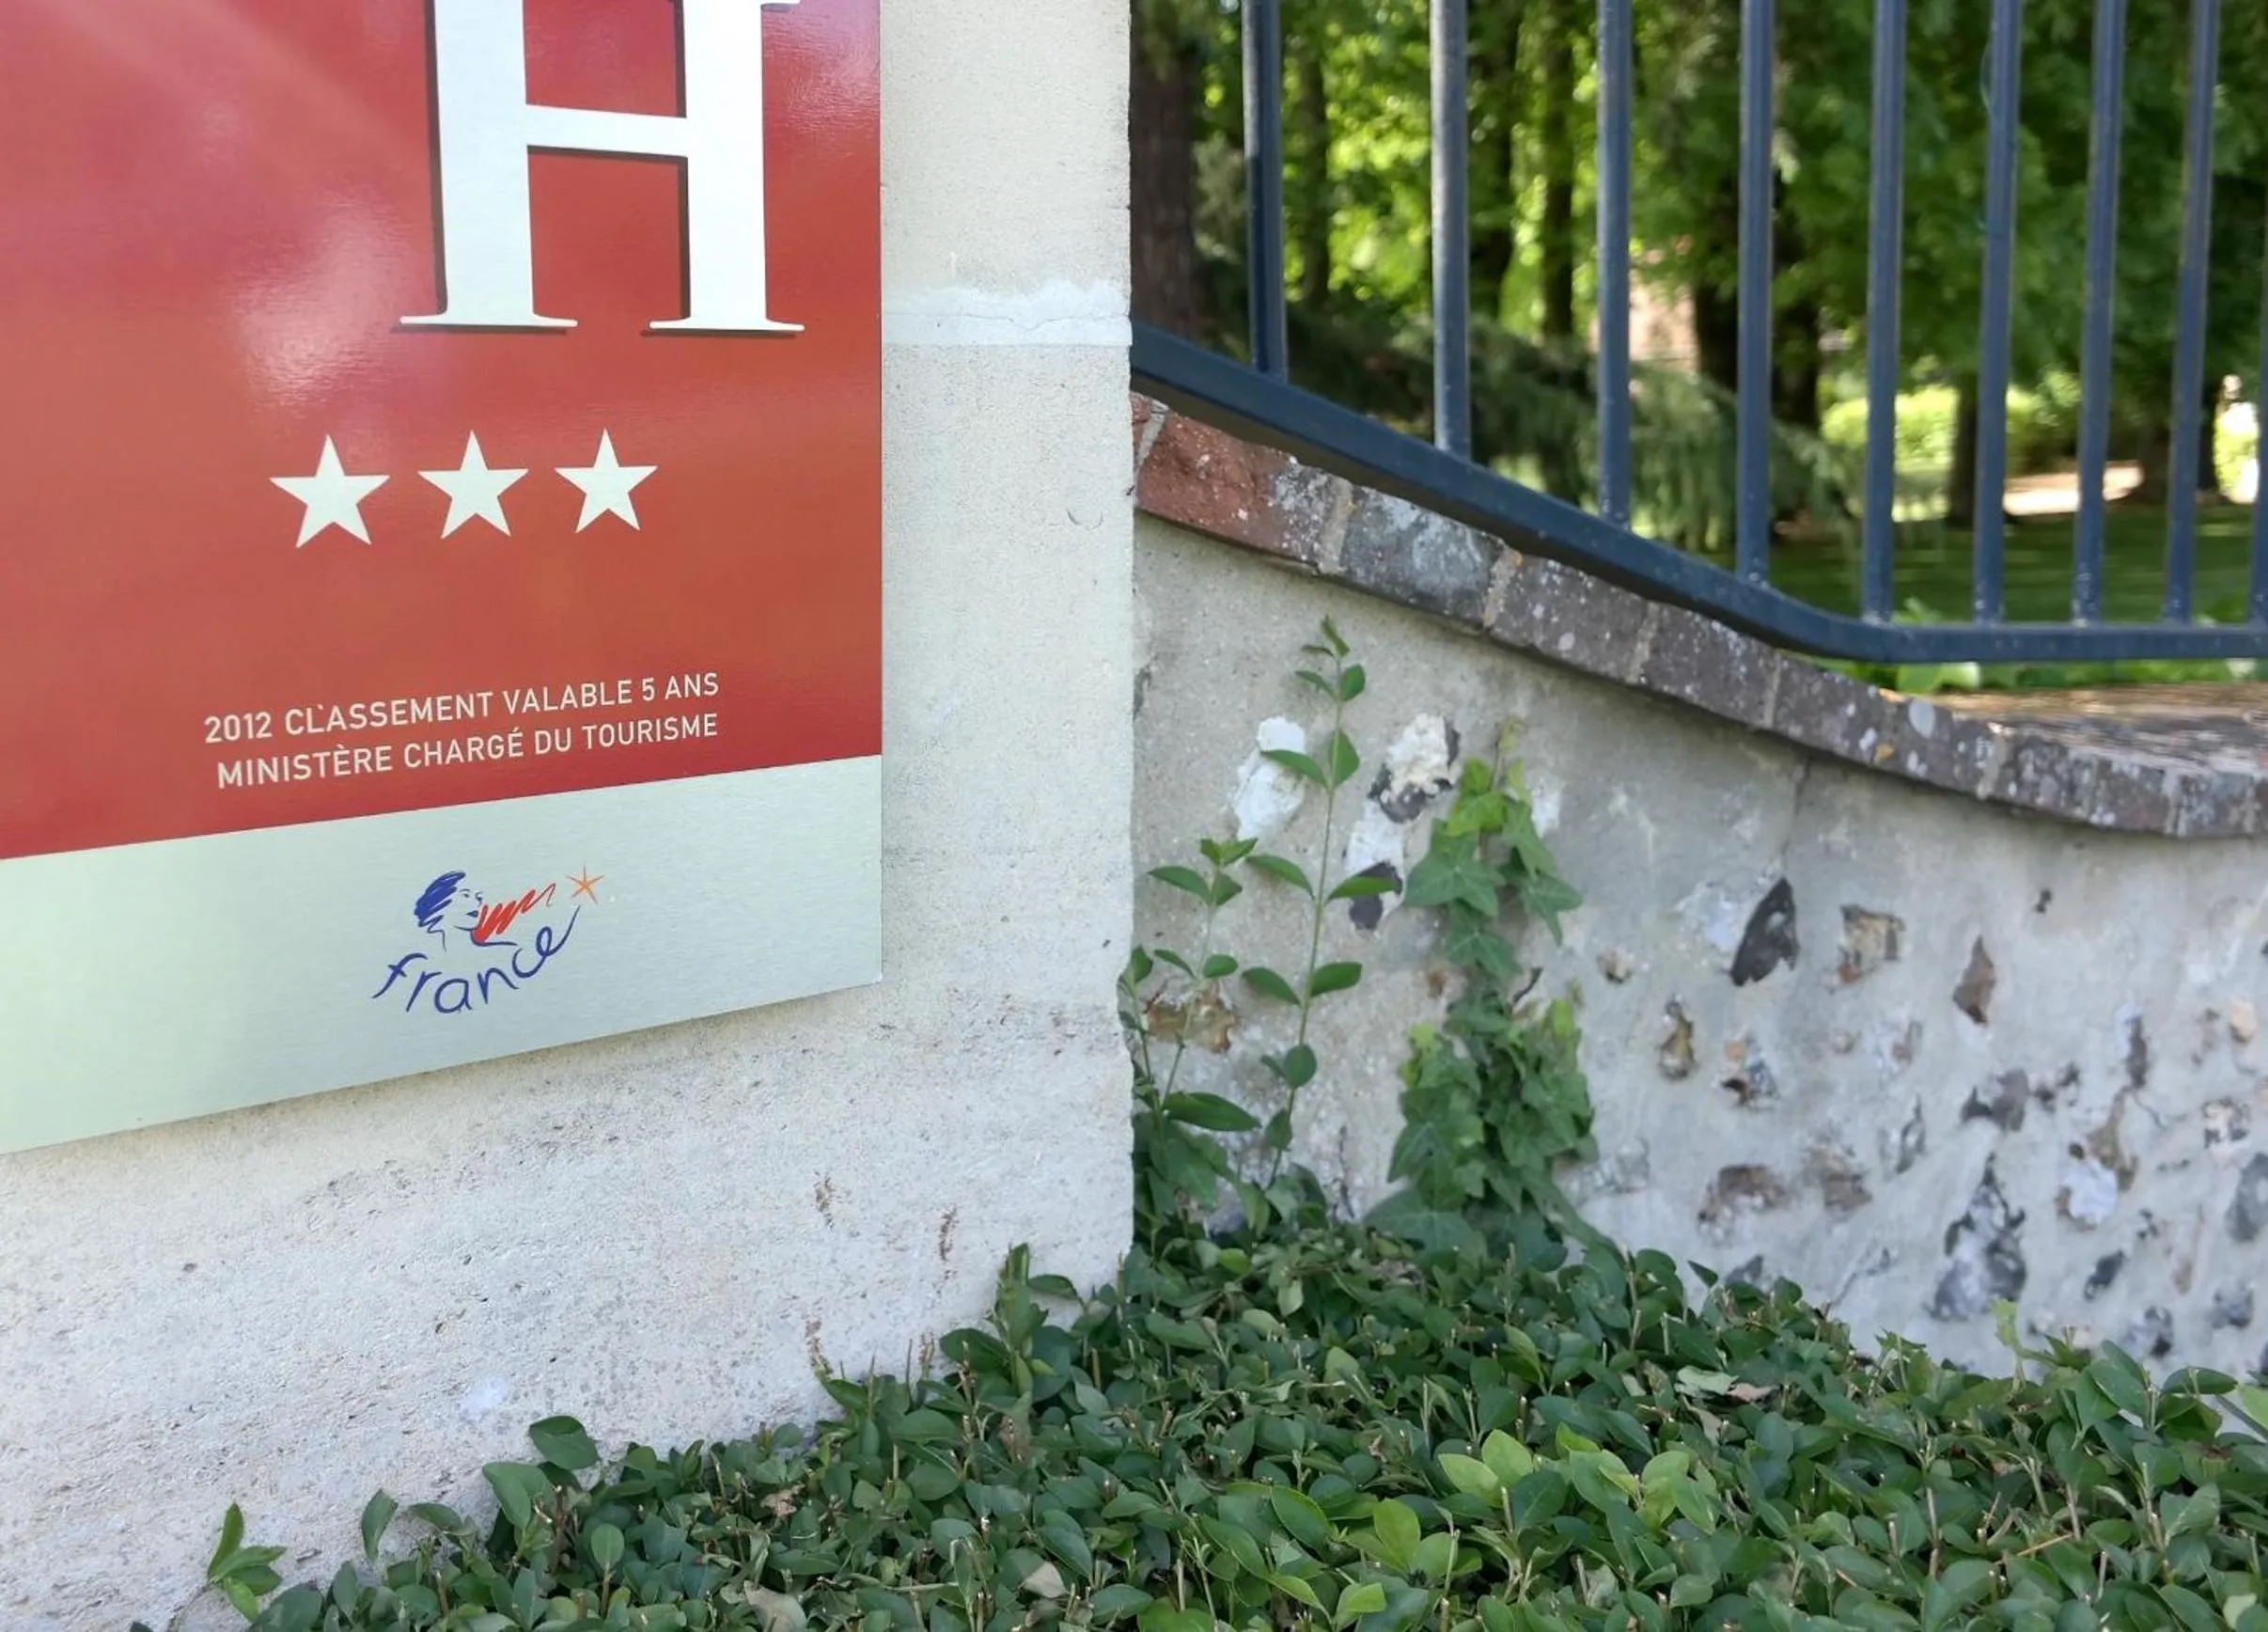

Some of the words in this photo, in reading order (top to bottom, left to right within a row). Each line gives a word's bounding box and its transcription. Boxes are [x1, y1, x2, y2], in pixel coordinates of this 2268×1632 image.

[399, 0, 806, 332] H
[204, 711, 273, 744] 2012
[503, 680, 633, 714] VALABLE
[642, 677, 656, 701] 5
[665, 672, 720, 700] ANS
[217, 745, 393, 789] MINISTÈRE
[404, 728, 524, 768] CHARGÉ
[534, 727, 571, 755] DU
[581, 713, 719, 749] TOURISME
[372, 905, 580, 1014] france
